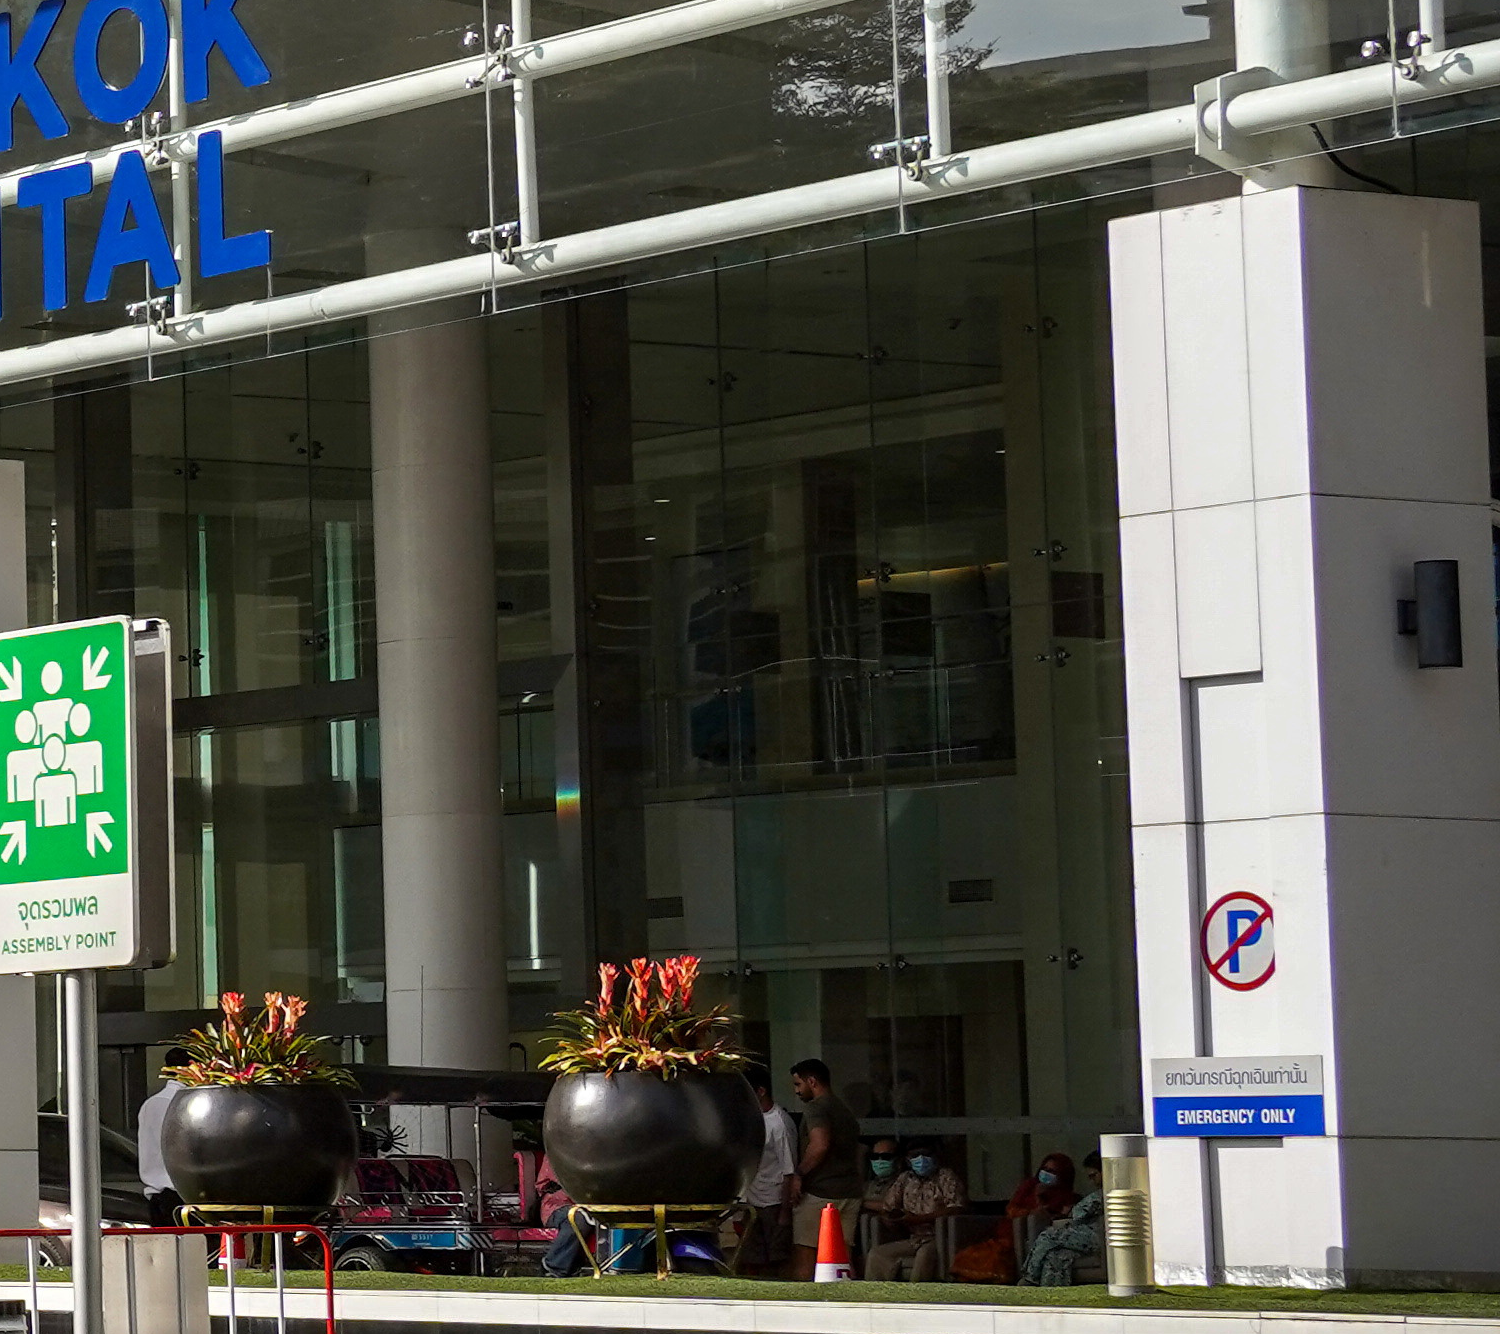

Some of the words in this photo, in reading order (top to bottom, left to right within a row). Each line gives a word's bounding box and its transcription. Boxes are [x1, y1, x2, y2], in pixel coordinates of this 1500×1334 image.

[17, 895, 99, 931] จุดรวมพล
[1, 934, 71, 955] ASSEMBLY
[75, 931, 117, 950] POINT
[1165, 1062, 1308, 1090] ยกเว้นกรณีฉุกเฉินเท่านั้น
[1176, 1109, 1255, 1125] EMERGENCY
[1261, 1108, 1296, 1124] ONLY
